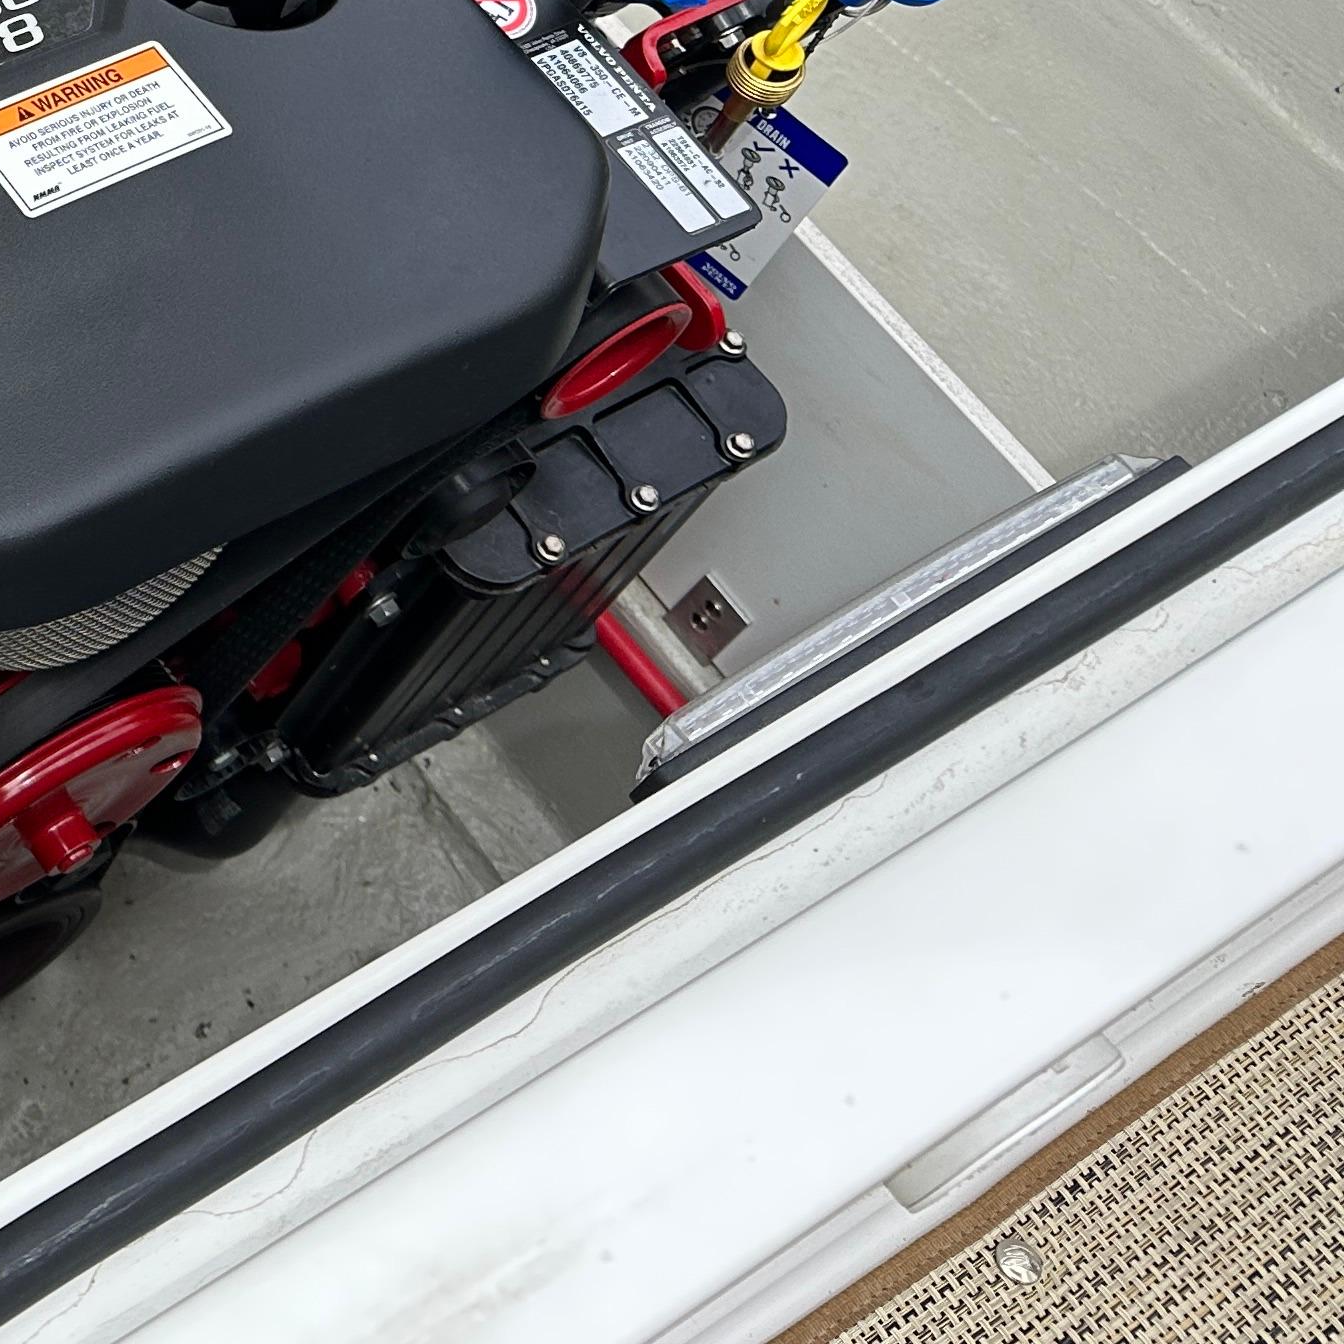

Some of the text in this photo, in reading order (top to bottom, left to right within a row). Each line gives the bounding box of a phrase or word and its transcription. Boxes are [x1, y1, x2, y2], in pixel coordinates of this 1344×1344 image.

[30, 67, 124, 114] WARNING
[576, 22, 657, 114] VOLVO PENTA
[7, 80, 161, 148] AVOID SERIOUS INJURY OR DEATH
[23, 140, 78, 167] RESULTING
[77, 128, 106, 145] FROM
[105, 111, 148, 134] LEAKING
[31, 96, 153, 151] FROM FIRE OR EXPLOSION
[755, 117, 792, 150] DRAIN
[33, 153, 75, 176] INSPECT
[75, 137, 115, 159] SYSTEM
[114, 129, 135, 143] FOR
[134, 115, 168, 134] LEAKS
[166, 110, 180, 121] AT
[66, 156, 98, 175] LEAST
[99, 144, 127, 161] ONCE
